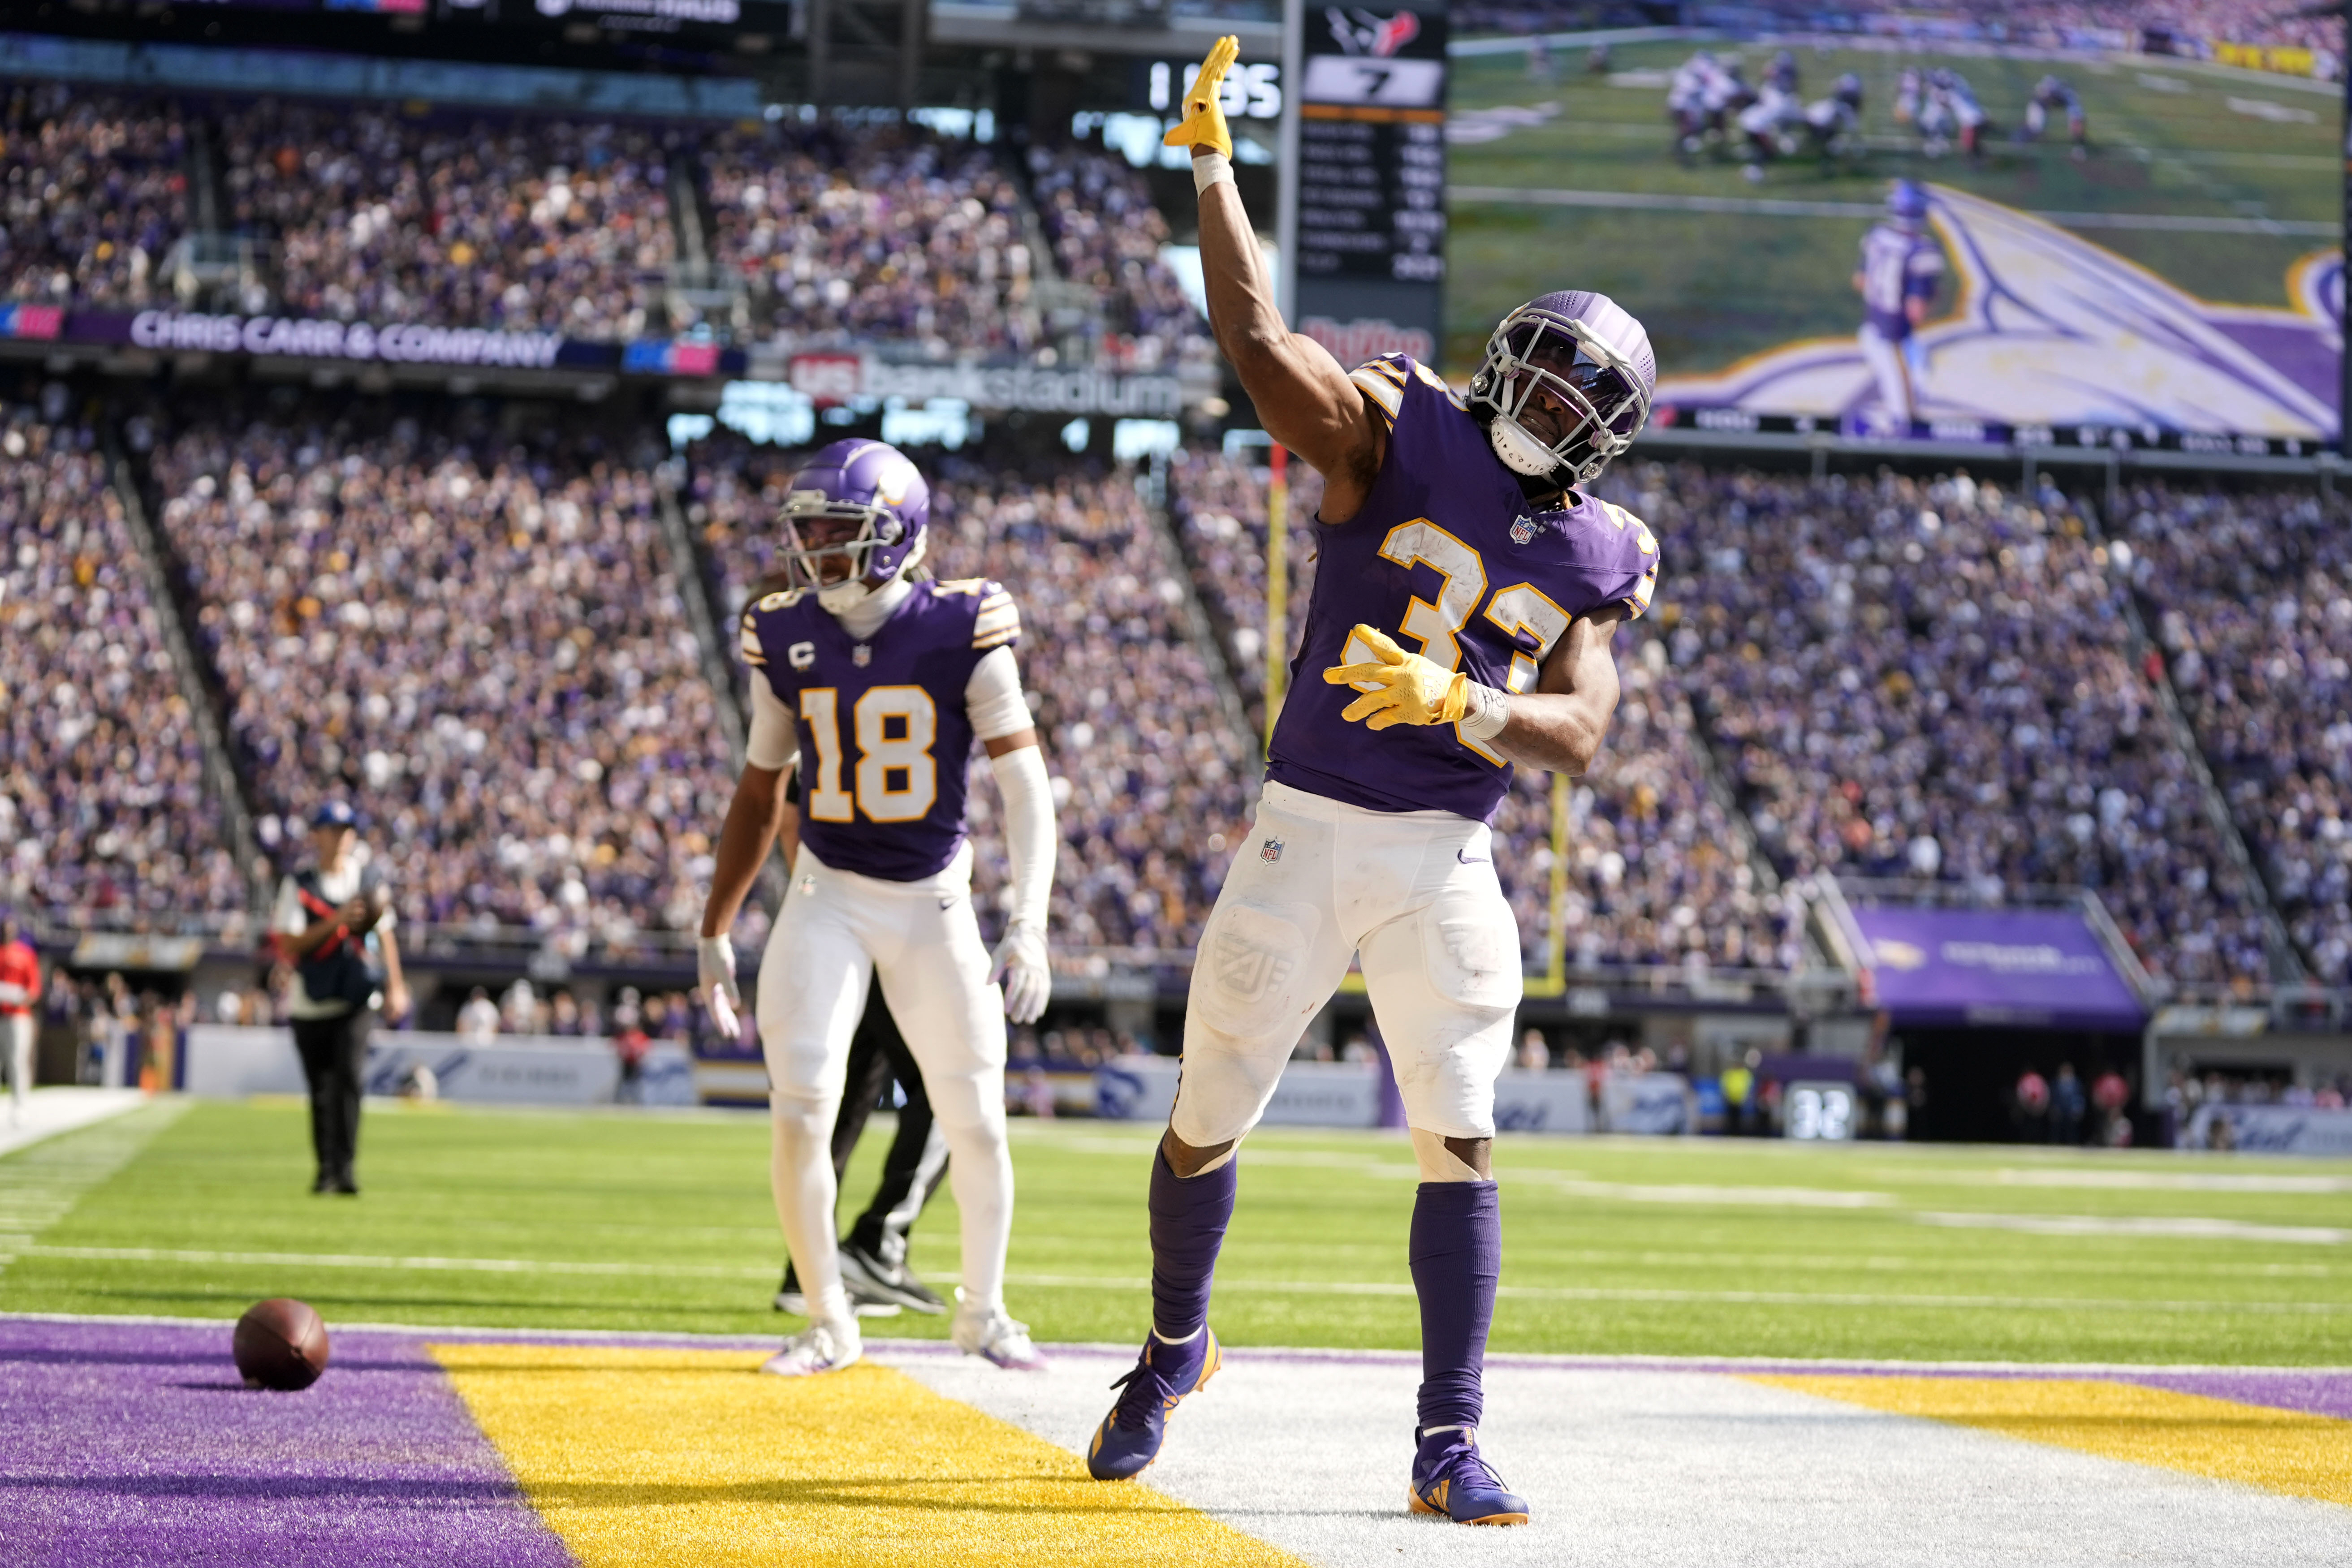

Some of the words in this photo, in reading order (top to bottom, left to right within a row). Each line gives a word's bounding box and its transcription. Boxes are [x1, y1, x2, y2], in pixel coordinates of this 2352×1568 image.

[1353, 67, 1392, 100] 7
[131, 310, 242, 352] CHRIS
[242, 315, 345, 356] CARR
[345, 320, 377, 359] &
[377, 323, 563, 369] COMPANY
[1513, 526, 1528, 541] NFL
[788, 641, 815, 668] C
[799, 685, 937, 824] 18
[1263, 849, 1277, 860] NFL
[1464, 1426, 1473, 1446] ZERO
